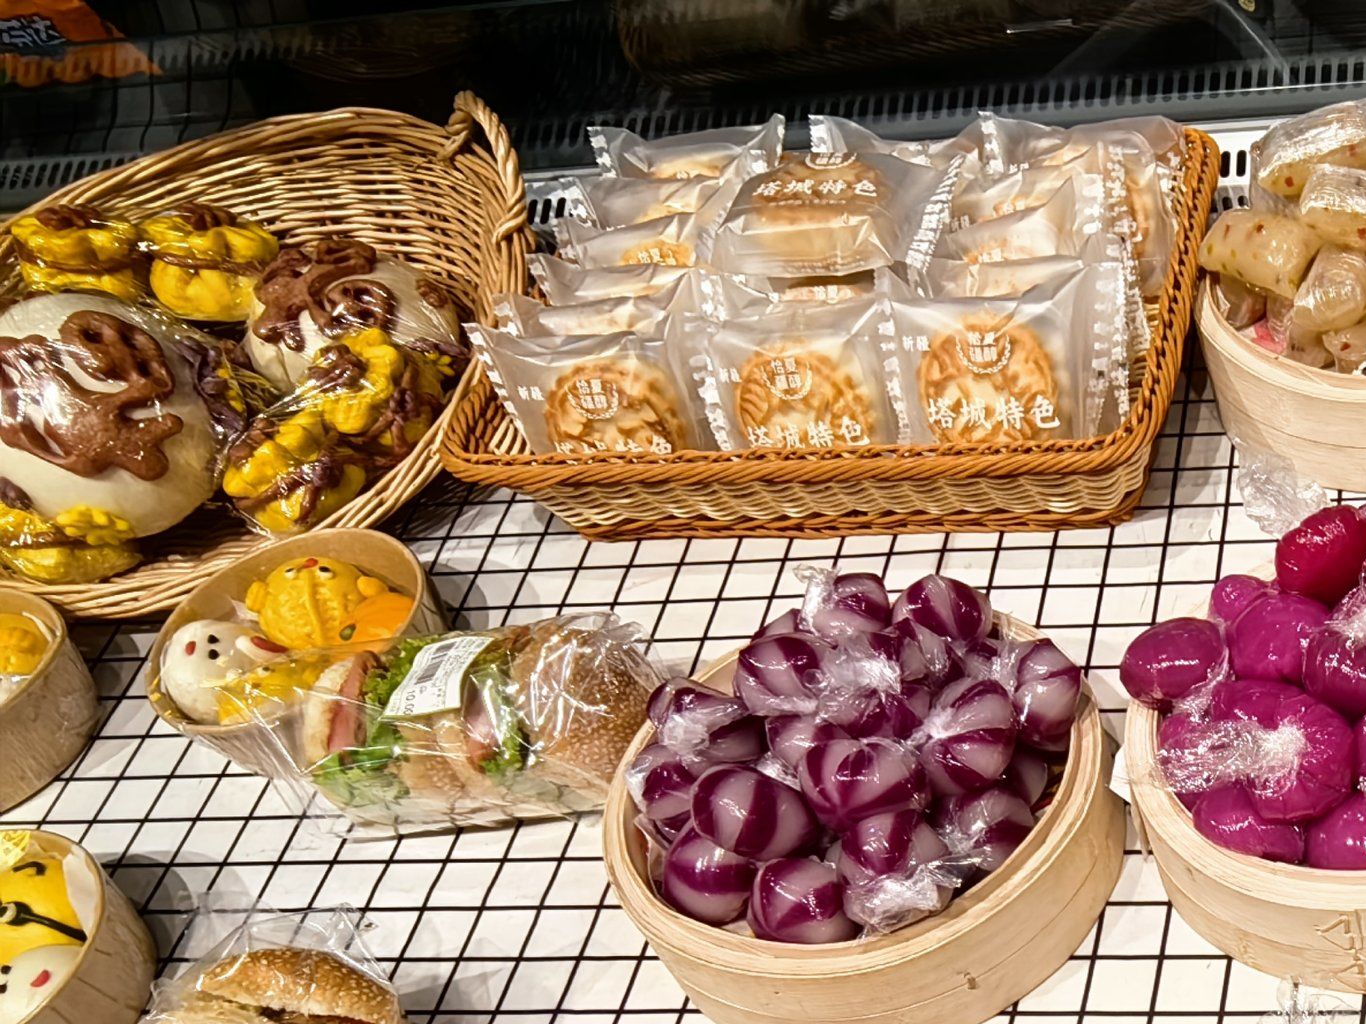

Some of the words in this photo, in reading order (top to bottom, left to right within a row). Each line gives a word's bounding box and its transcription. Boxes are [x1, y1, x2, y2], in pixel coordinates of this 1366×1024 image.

[752, 179, 877, 197] 塔城特色
[928, 394, 1061, 430] 塔城特色
